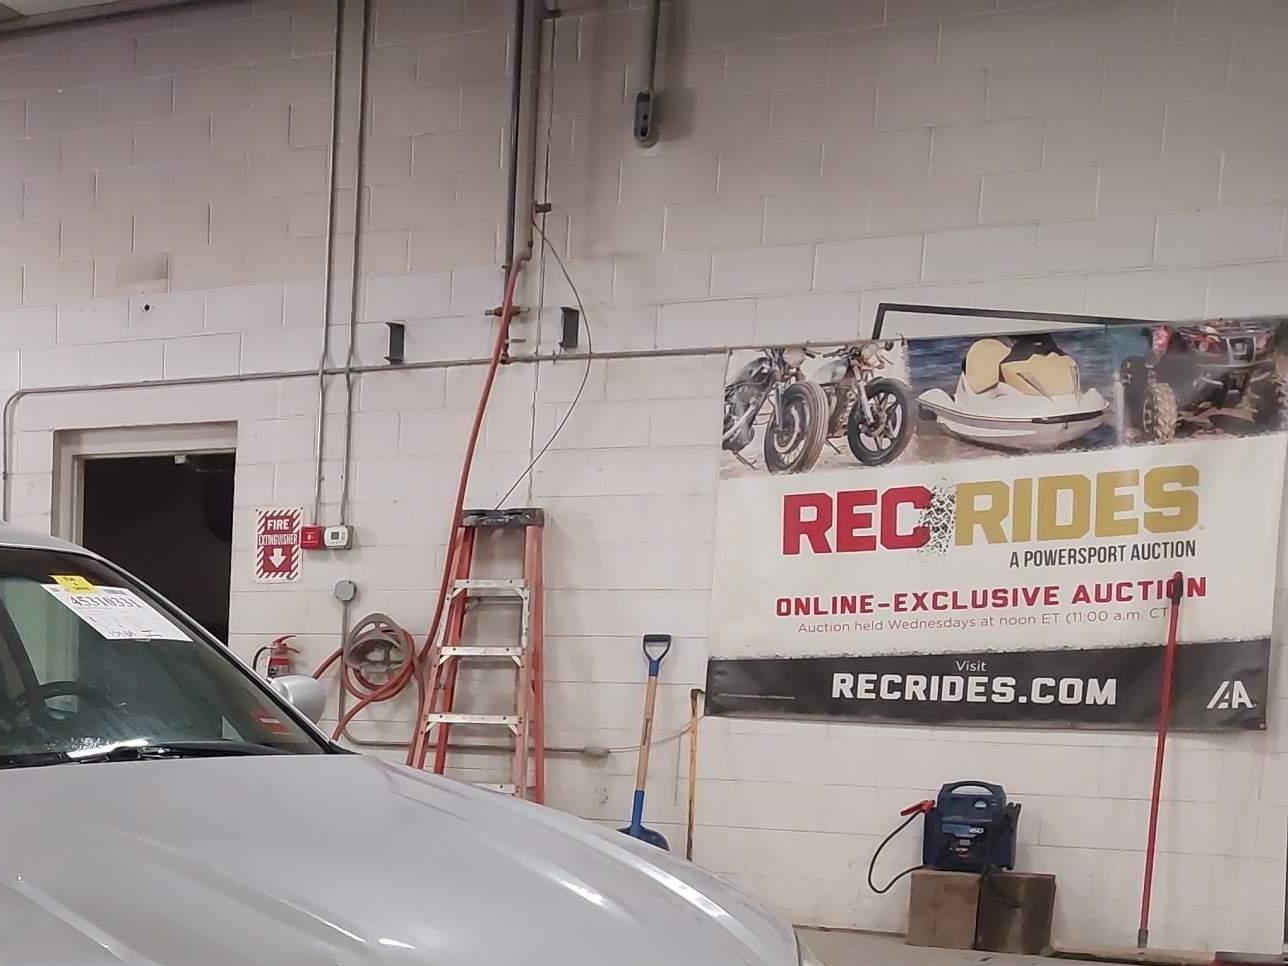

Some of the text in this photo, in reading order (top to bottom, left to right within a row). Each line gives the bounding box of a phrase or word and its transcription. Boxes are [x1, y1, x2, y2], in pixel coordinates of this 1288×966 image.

[783, 465, 1200, 555] REC RIDES
[266, 518, 290, 531] FIRE
[258, 533, 298, 546] EXTINGUISHER
[1009, 539, 1197, 568] A POWERSPORT AUCTION
[776, 585, 1060, 617] ONLINE-EXCLUSIVE
[798, 622, 850, 634] Auction
[854, 620, 883, 632] held
[888, 617, 976, 631] Wednesdays
[980, 616, 994, 627] at
[999, 615, 1036, 626] noon
[1041, 613, 1061, 625] ET
[1065, 610, 1107, 625] (11:00
[955, 660, 987, 672] Visit
[831, 672, 1117, 705] RECRIDES.COM
